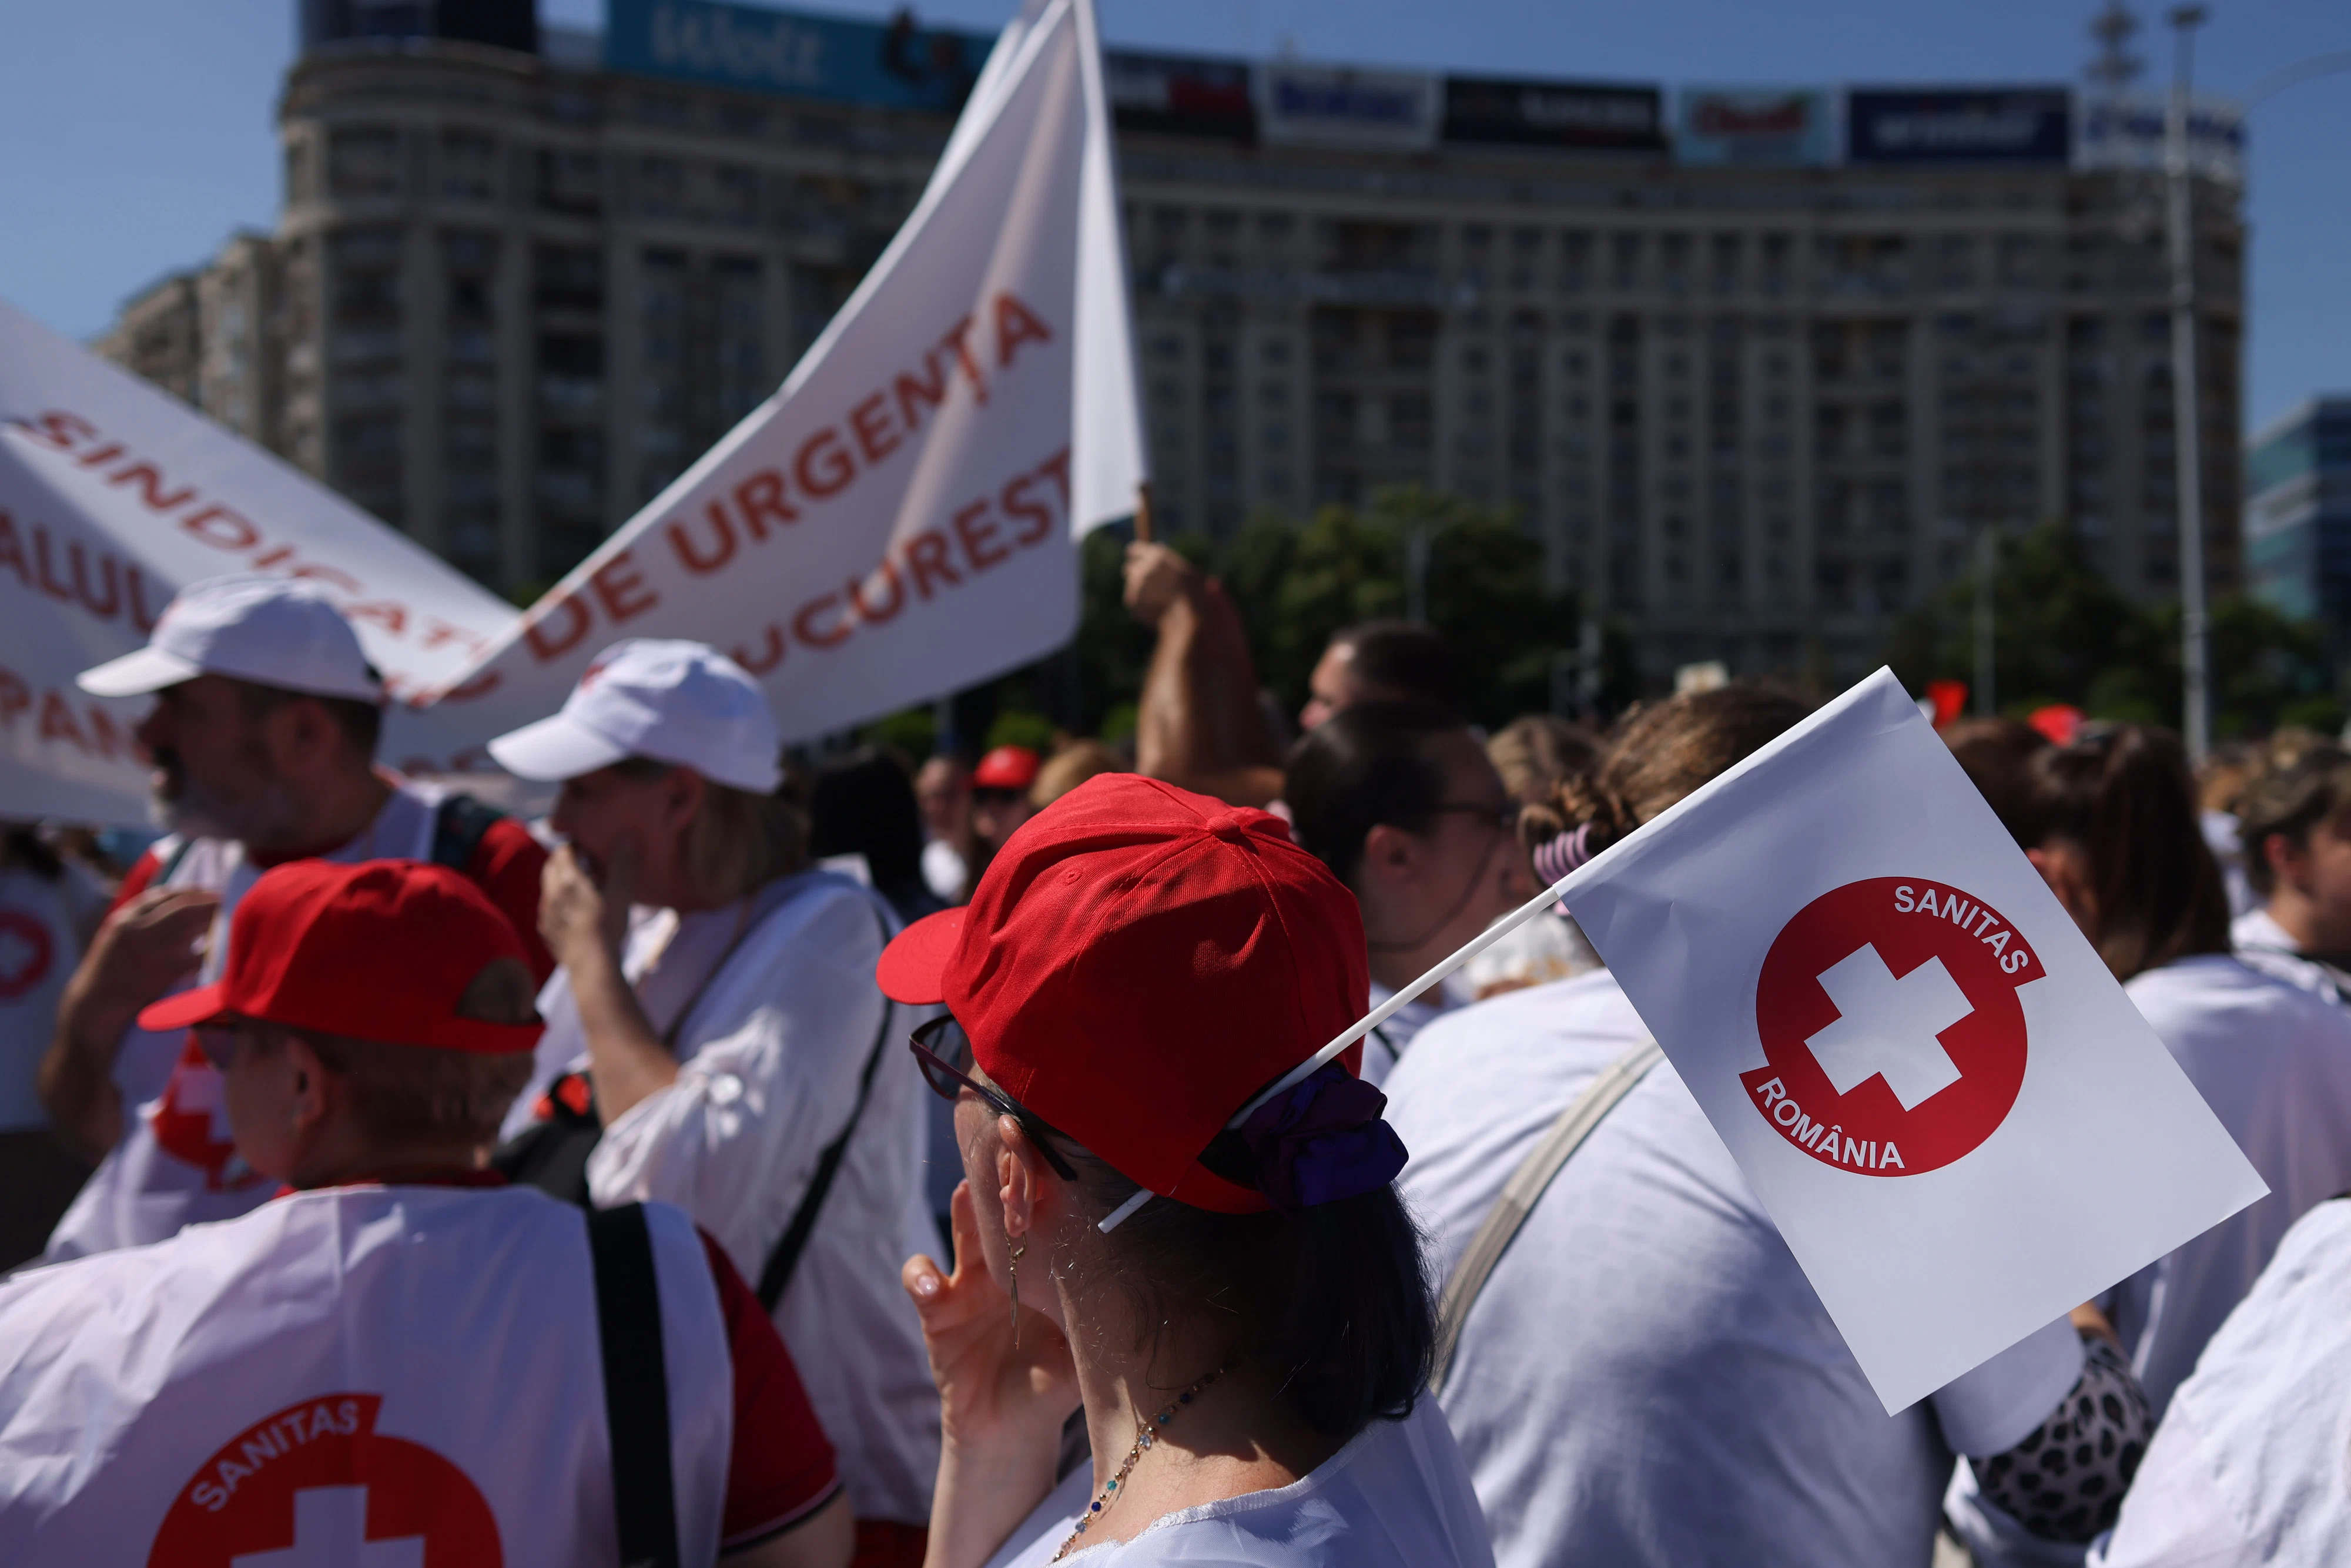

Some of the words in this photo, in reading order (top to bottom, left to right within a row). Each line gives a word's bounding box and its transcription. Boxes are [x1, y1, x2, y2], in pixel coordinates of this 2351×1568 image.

[21, 410, 493, 658] SINDICAT
[734, 448, 1071, 676] UCUREST
[525, 549, 659, 662] DE
[1894, 885, 2029, 974] SANITAS
[1756, 1076, 1905, 1169] ROMÂNIA
[190, 1400, 359, 1512] SANITAS
